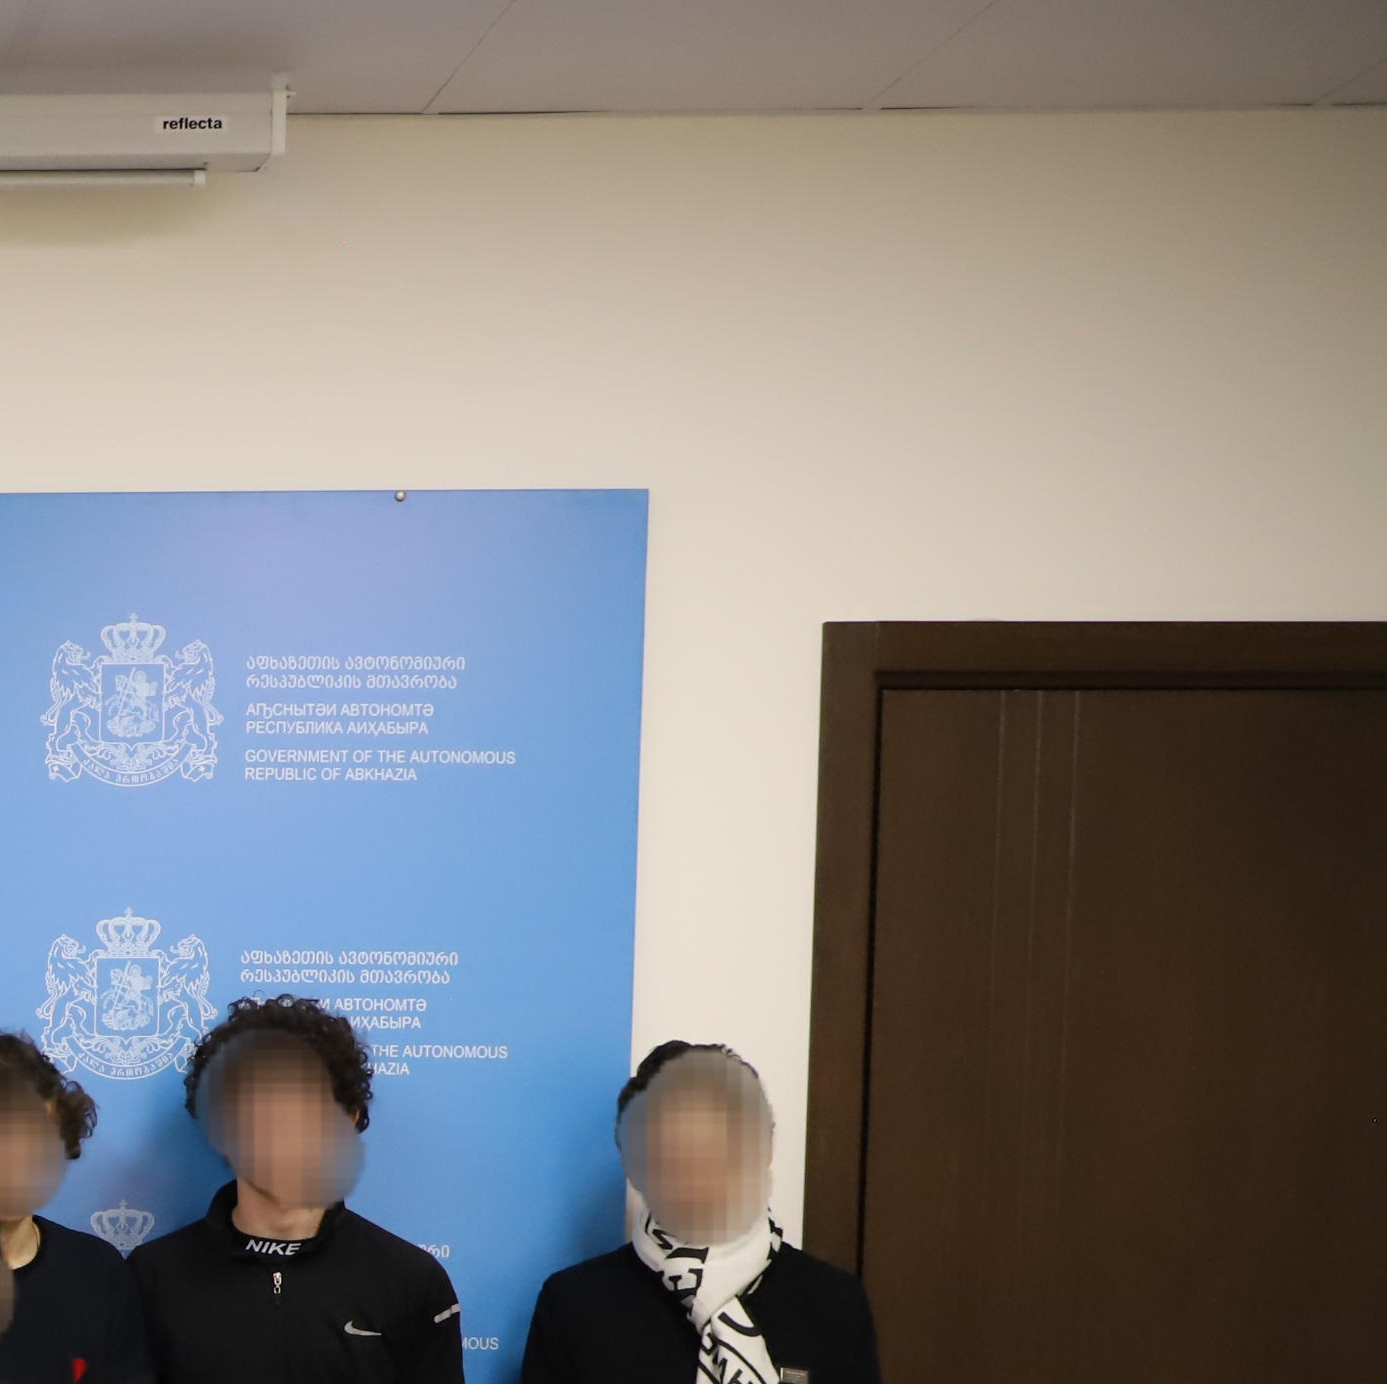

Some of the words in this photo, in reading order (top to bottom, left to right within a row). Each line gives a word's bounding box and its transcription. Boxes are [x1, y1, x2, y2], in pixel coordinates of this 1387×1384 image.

[161, 116, 224, 130] reflecta
[246, 721, 344, 734] РЕСПУБЛИКА
[244, 749, 349, 762] GOVERNMENT
[352, 750, 373, 763] OF
[377, 750, 406, 763] THE
[409, 750, 516, 764] AUTONOMOUS
[244, 767, 317, 780] REPUBLIC
[320, 768, 342, 780] OF
[344, 768, 418, 780] ABKHAZIA
[371, 1044, 399, 1058] THE
[402, 1045, 509, 1059] AUTONOMOUS
[245, 1239, 302, 1256] NIKE
